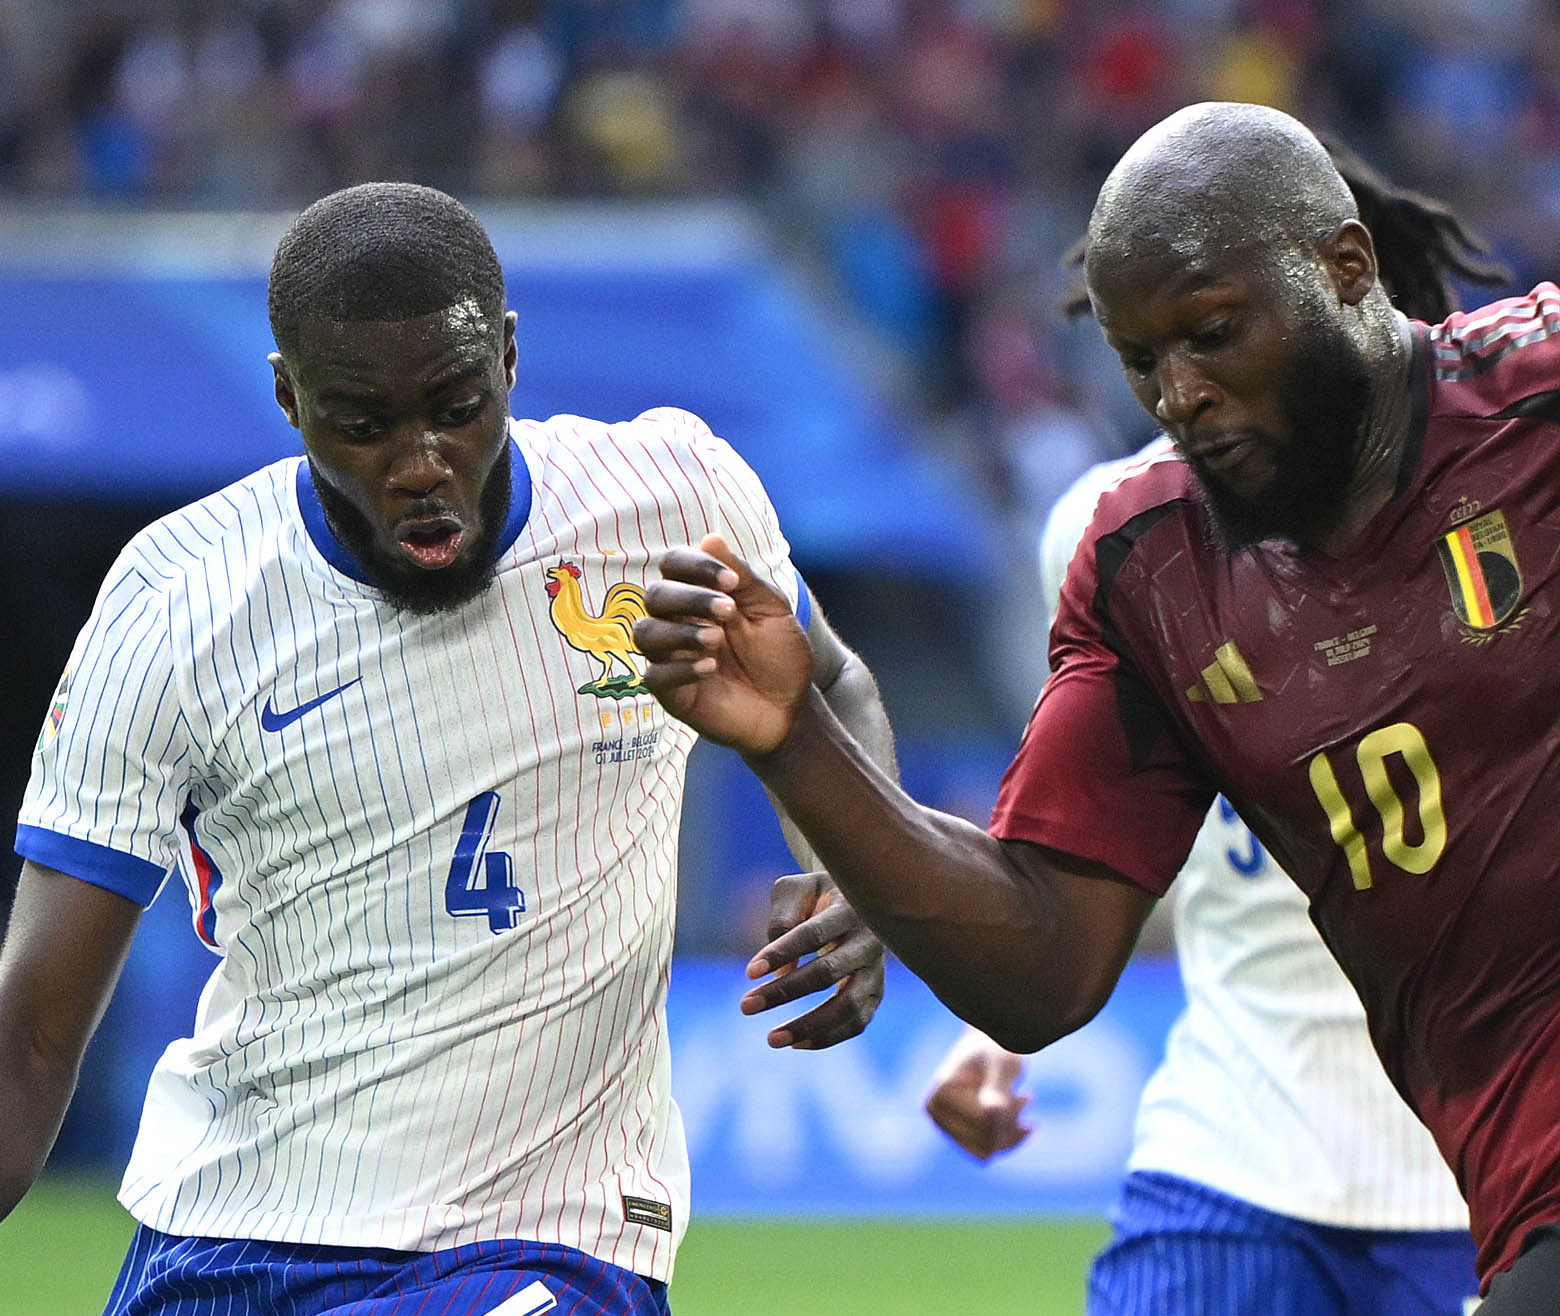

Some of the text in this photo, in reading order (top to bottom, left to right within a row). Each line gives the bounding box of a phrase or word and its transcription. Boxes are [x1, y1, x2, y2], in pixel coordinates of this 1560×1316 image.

[592, 738, 623, 752] FRANCE
[1309, 722, 1447, 890] 10
[445, 791, 526, 935] 4
